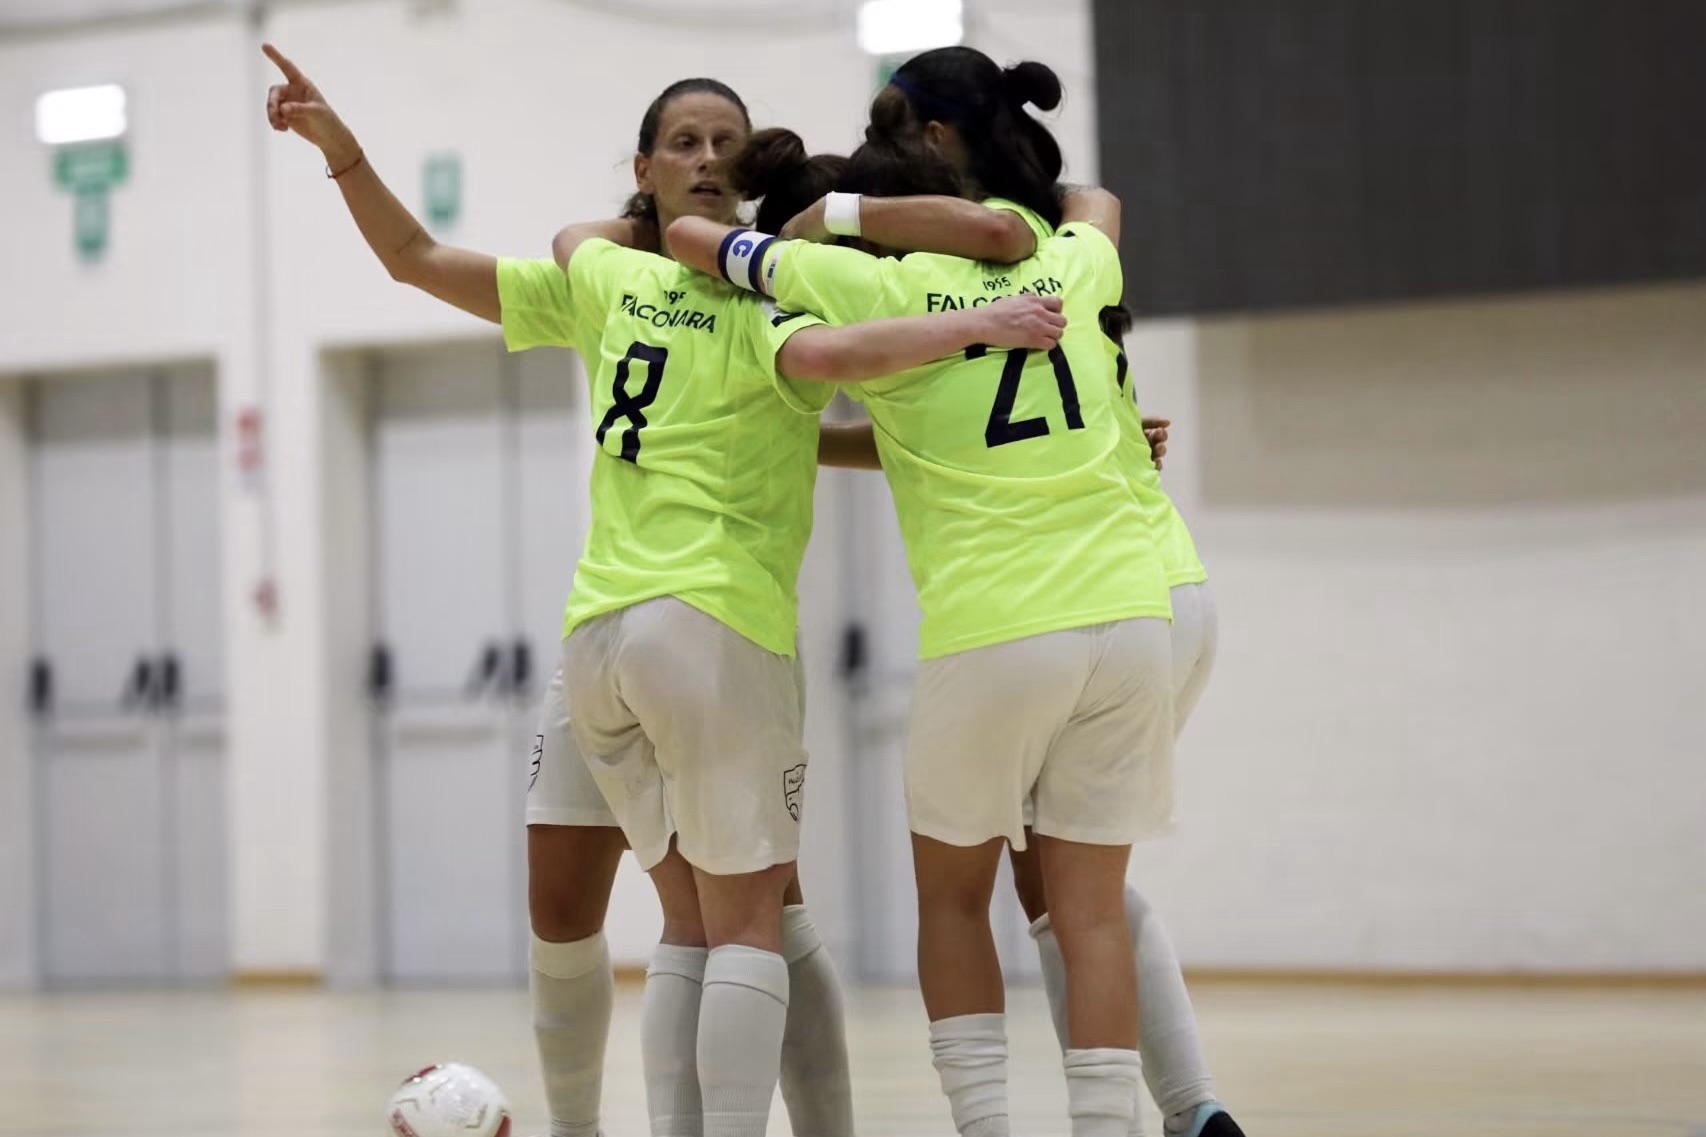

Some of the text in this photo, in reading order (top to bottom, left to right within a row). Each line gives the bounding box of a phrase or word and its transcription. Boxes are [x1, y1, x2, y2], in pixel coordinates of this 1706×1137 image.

[732, 239, 754, 258] C
[595, 340, 669, 465] 8
[964, 341, 1086, 449] 21
